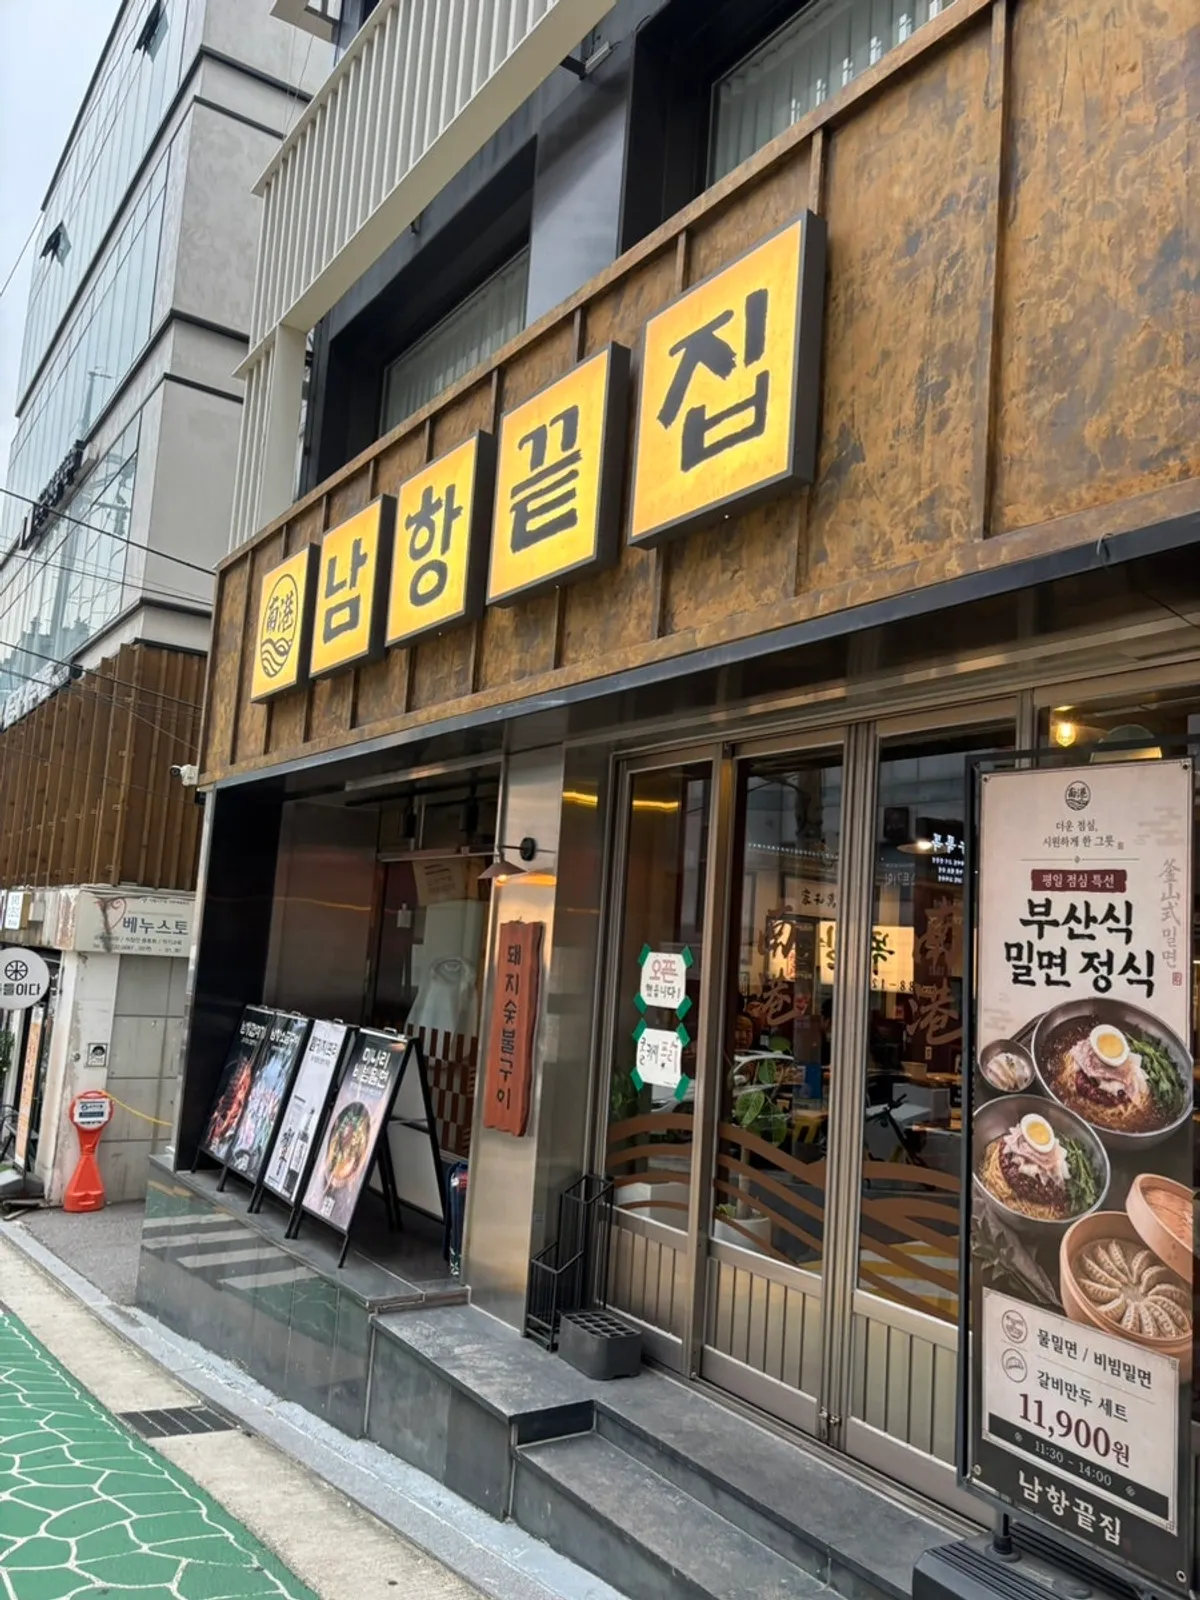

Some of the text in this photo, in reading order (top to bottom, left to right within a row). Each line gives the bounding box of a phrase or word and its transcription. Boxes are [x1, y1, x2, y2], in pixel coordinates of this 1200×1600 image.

[322, 288, 769, 645] 남항끝집
[1043, 835, 1079, 849] 시원하게
[1082, 834, 1092, 848] 한
[1094, 834, 1115, 848] 그릇
[1055, 819, 1074, 832] 더운
[1042, 873, 1115, 889] 평일 점심 특선
[122, 916, 189, 935] 베누스토
[1019, 897, 1134, 945] 부산식
[649, 959, 679, 984] 오픈
[1004, 940, 1155, 999] 밀면 정식
[496, 944, 522, 1111] 돼지숯불구이
[1037, 1328, 1078, 1361] 물밀면
[1093, 1350, 1152, 1389] 비빔밀면
[1037, 1369, 1128, 1423] 갈비만두 세트
[1018, 1393, 1130, 1468] 11,900원
[1035, 1440, 1064, 1463] 11:30
[1078, 1462, 1112, 1487] 14:00
[1018, 1469, 1121, 1546] 남항끝집
